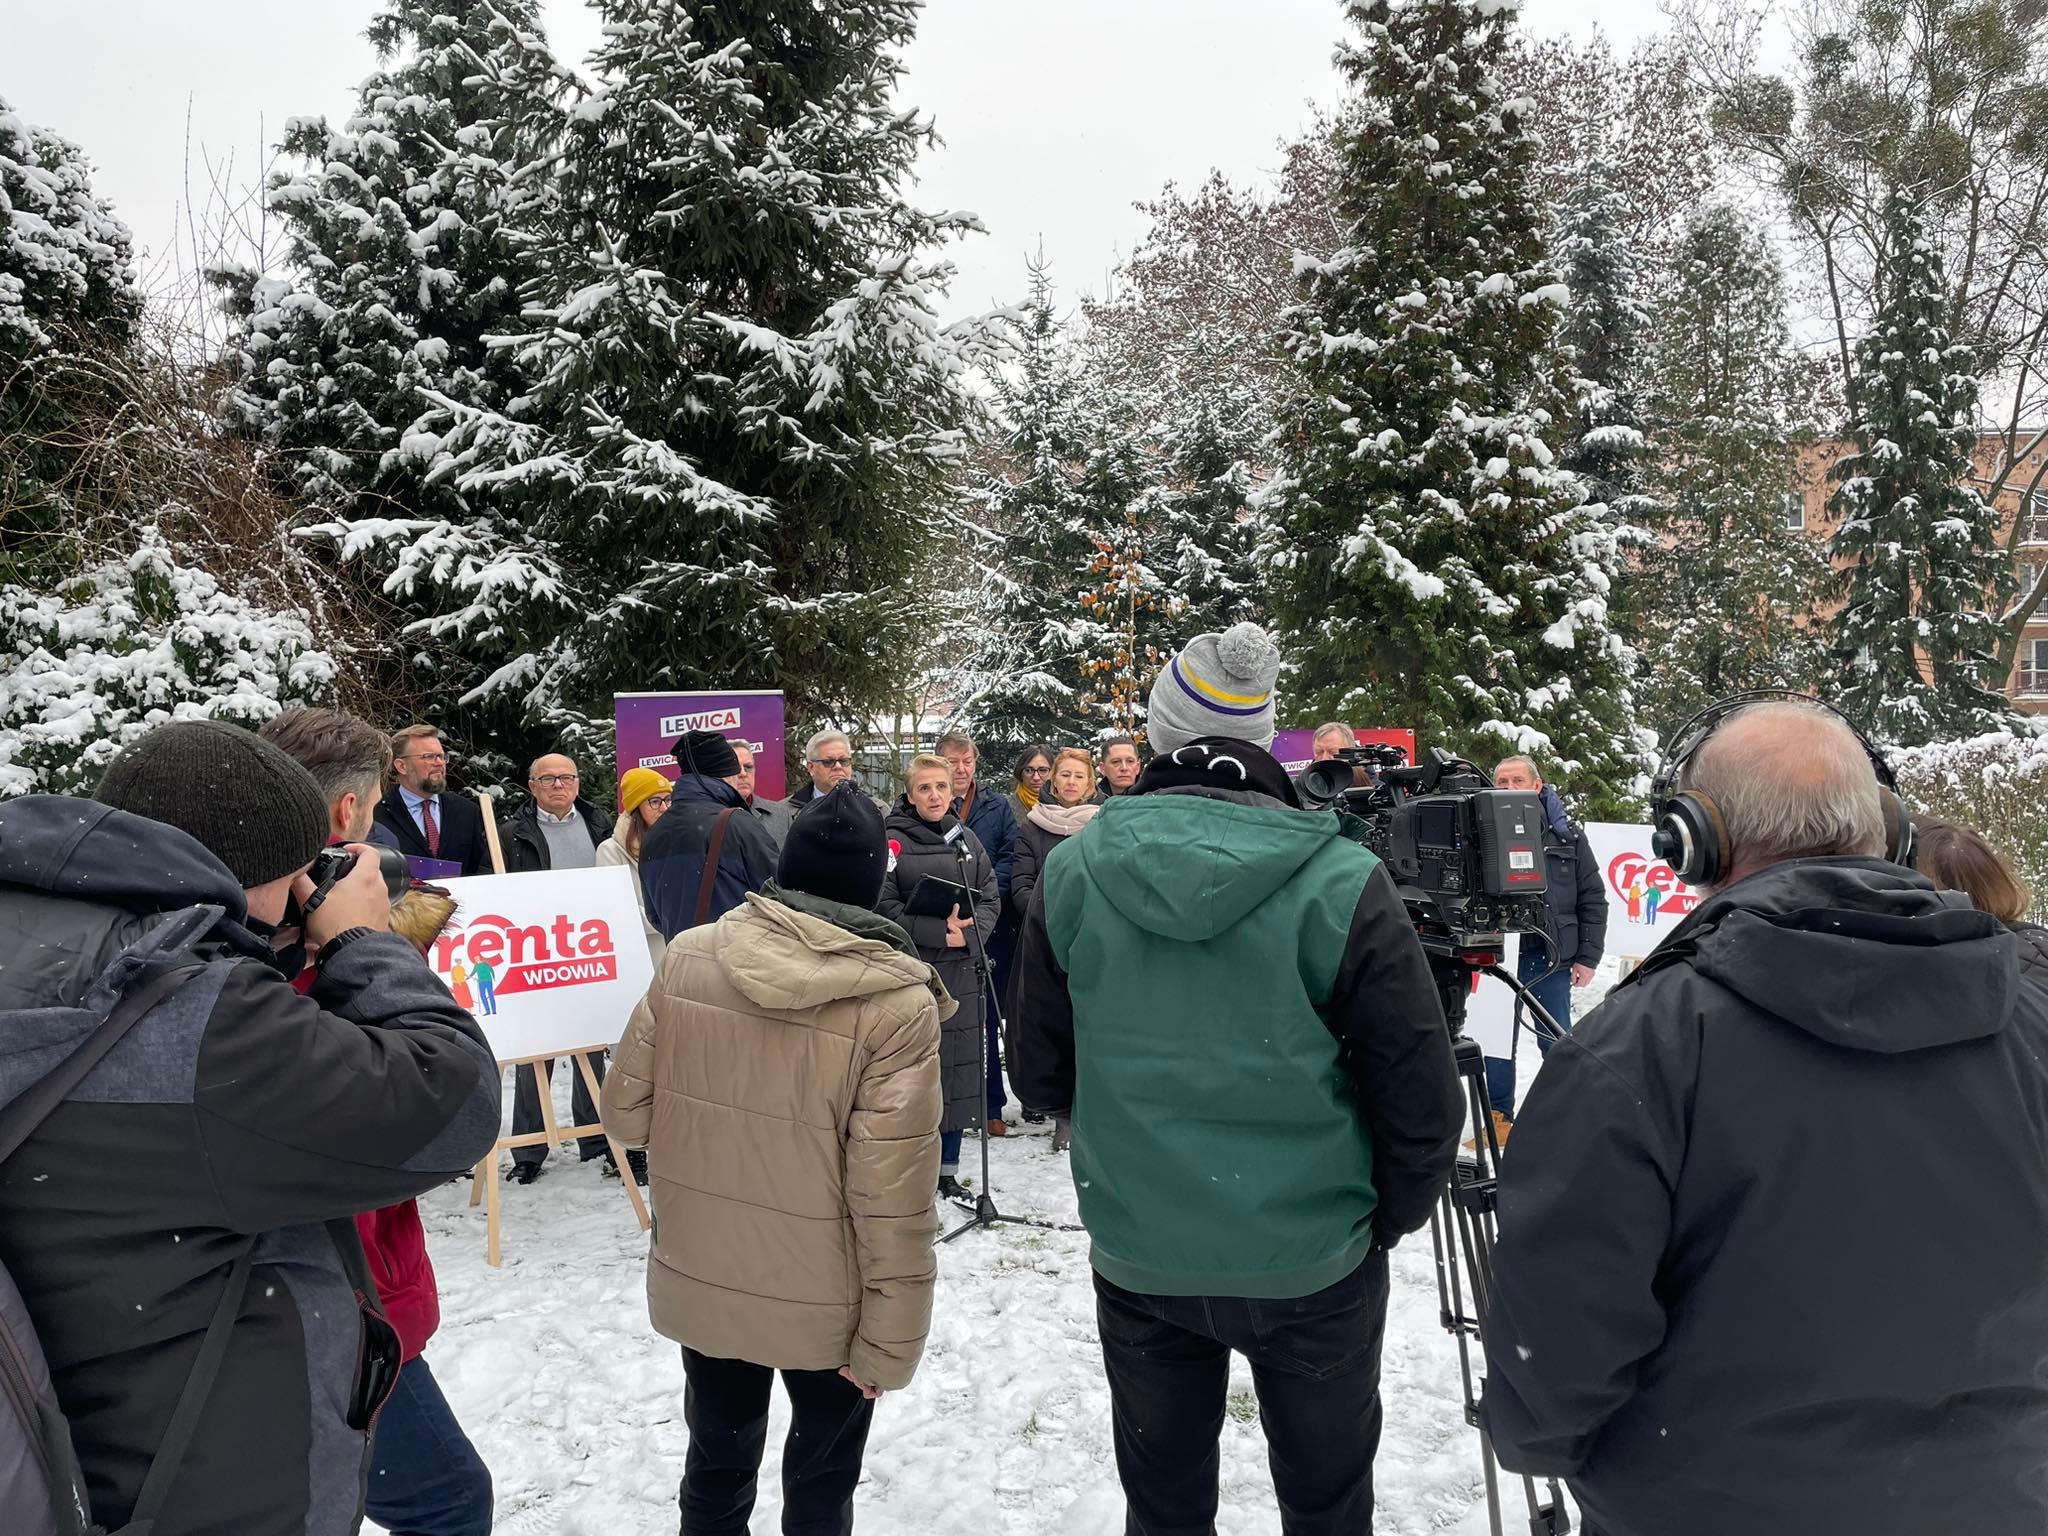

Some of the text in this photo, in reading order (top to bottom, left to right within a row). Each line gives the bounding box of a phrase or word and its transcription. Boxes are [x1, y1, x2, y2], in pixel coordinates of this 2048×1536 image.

[666, 711, 736, 734] LEWICA
[434, 914, 614, 973] renta
[523, 963, 608, 986] WDOWIA
